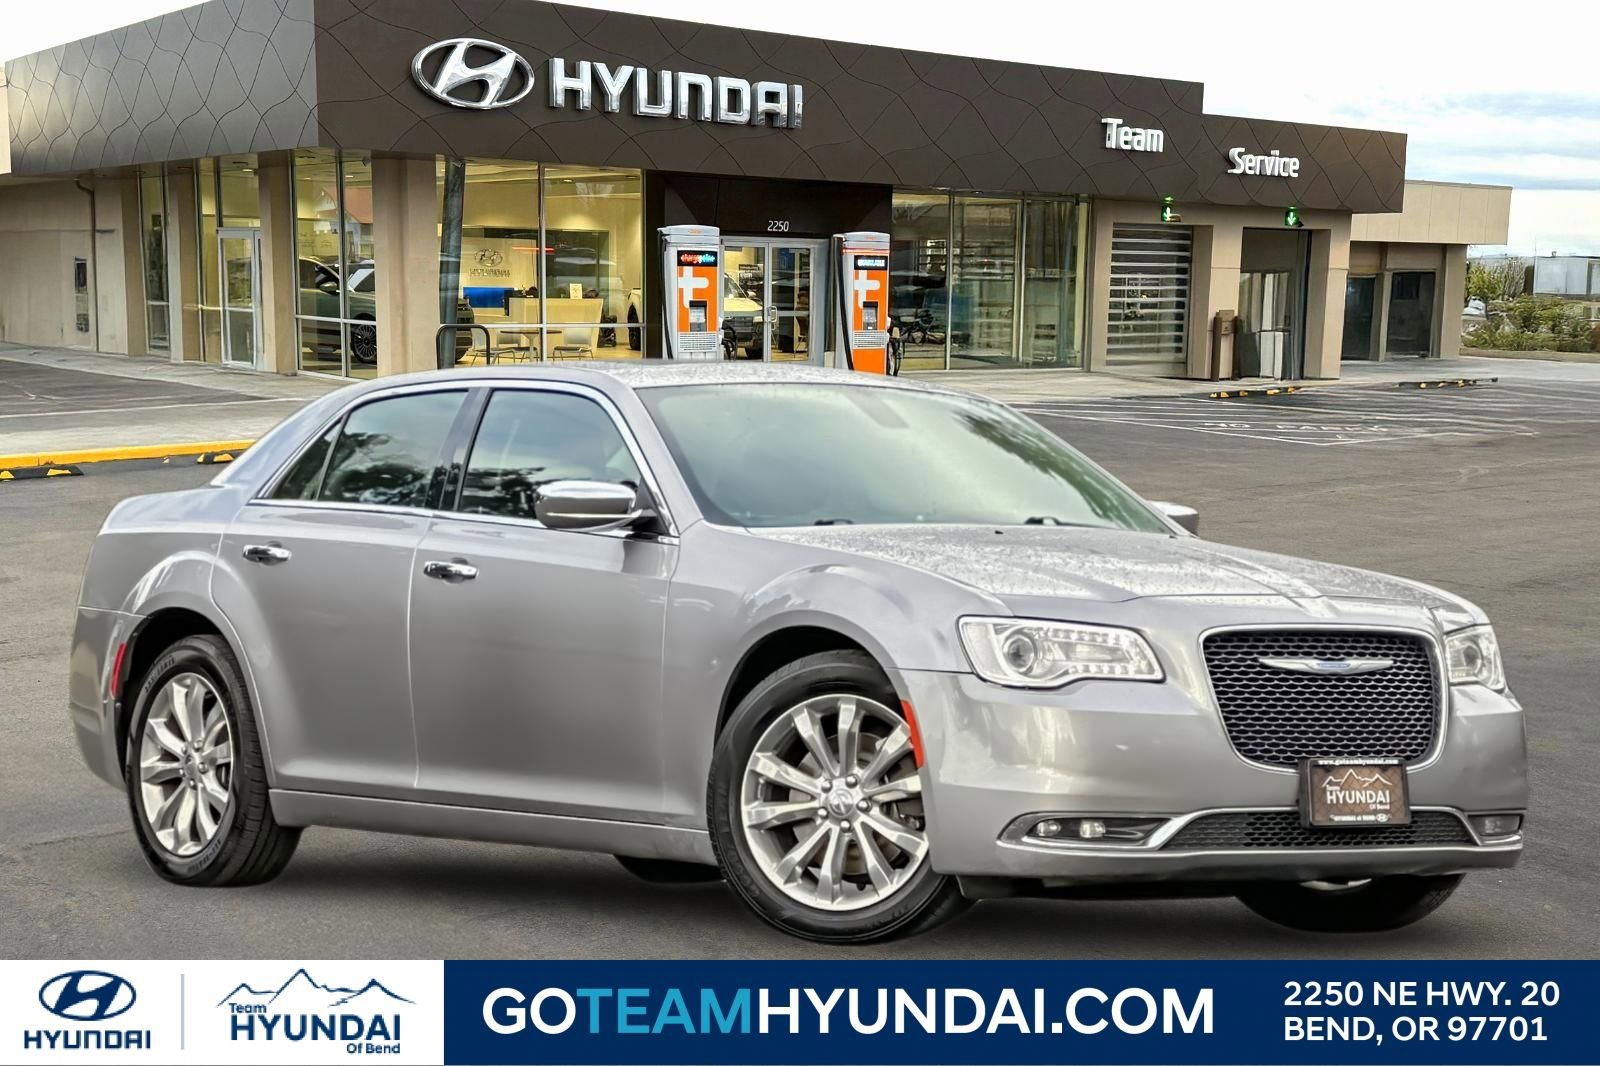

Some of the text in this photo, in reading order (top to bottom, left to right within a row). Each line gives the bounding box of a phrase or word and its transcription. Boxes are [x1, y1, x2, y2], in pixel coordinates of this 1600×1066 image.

[549, 57, 803, 128] HYUNDAI
[1101, 117, 1164, 152] Team
[1227, 147, 1300, 178] Service
[767, 220, 790, 232] 2250
[1326, 790, 1390, 804] HYUNDAI
